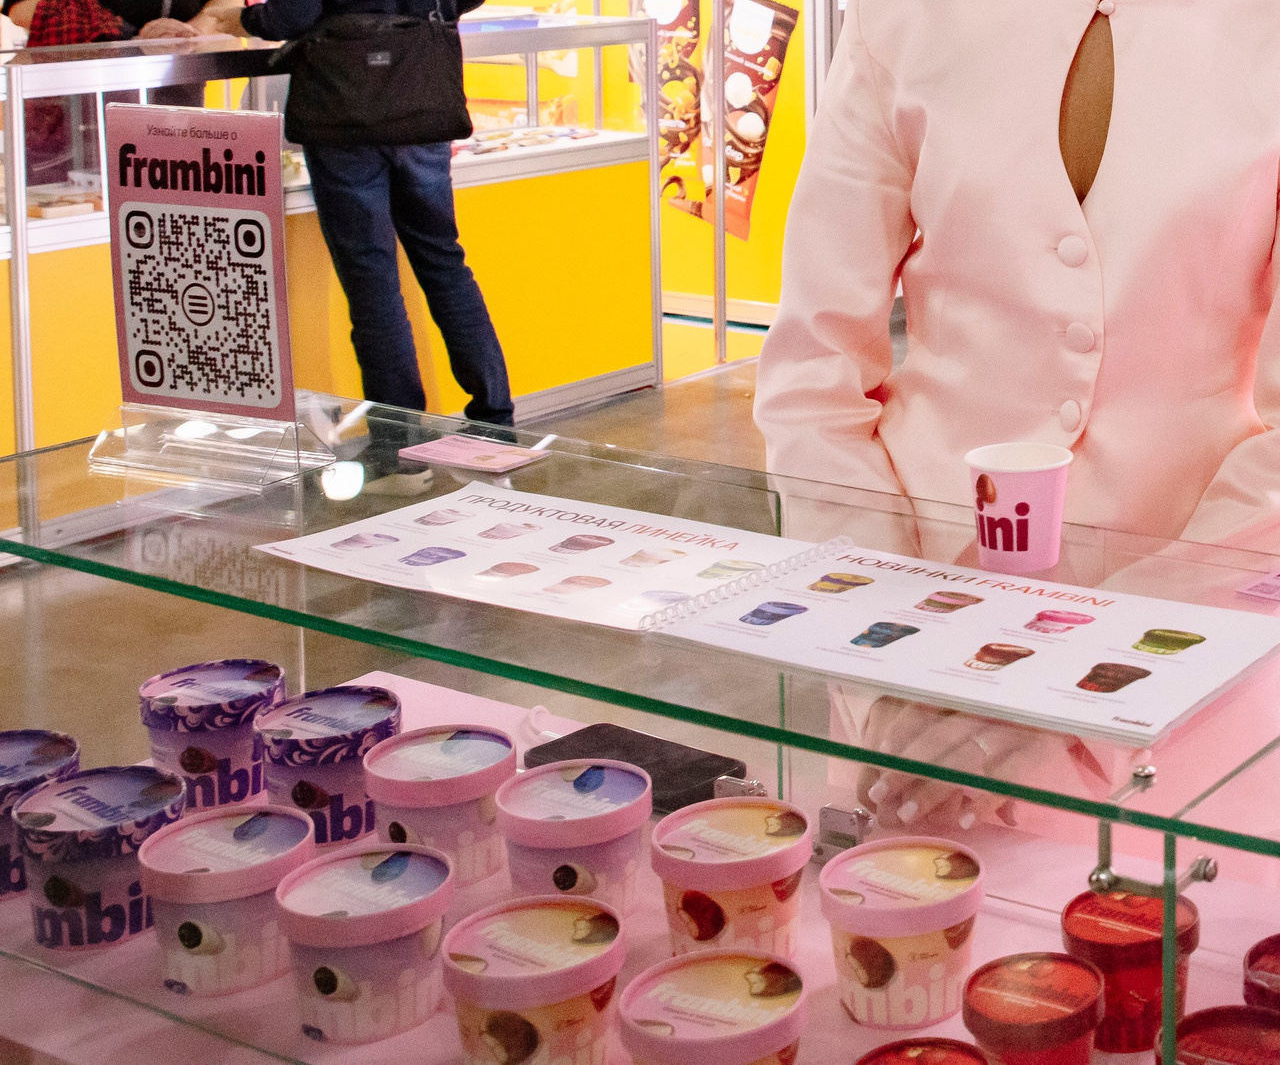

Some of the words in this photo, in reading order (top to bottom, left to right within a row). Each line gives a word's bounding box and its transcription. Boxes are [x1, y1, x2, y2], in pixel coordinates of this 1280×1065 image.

[146, 123, 188, 138] Узнайте
[189, 127, 229, 140] больше
[230, 132, 237, 140] о
[118, 143, 266, 197] frambini
[458, 494, 627, 531] ПРОДУКТОВАЯ
[623, 523, 740, 552] ЛИНЕЙКА
[835, 554, 978, 584] НОВИНКИ
[975, 578, 1118, 608] FRAMBINI
